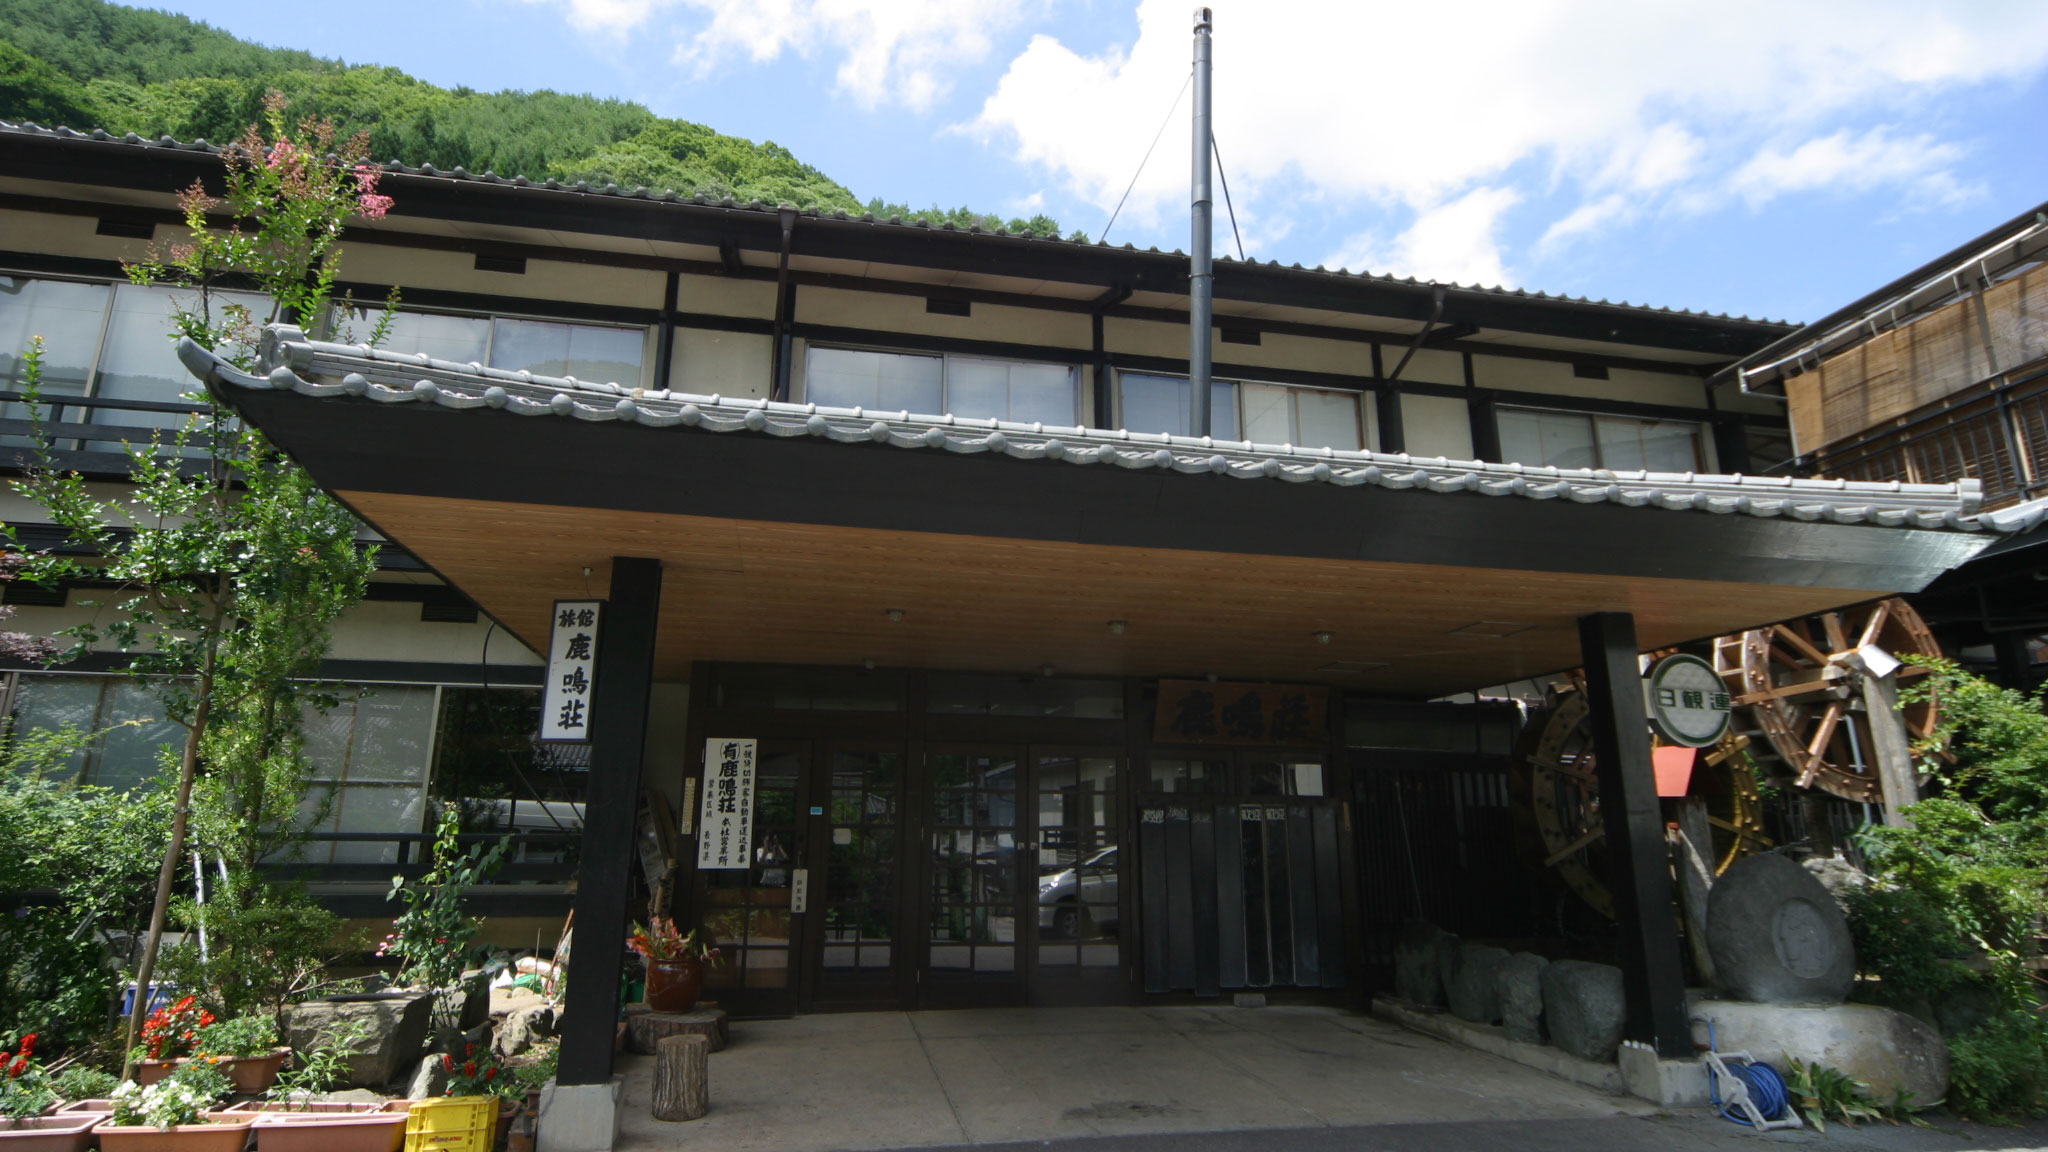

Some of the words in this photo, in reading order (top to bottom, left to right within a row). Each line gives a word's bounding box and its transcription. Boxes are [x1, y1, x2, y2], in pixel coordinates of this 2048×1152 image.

[558, 608, 595, 628] 旅館
[557, 632, 592, 730] 鹿鳴荘
[1657, 687, 1731, 711] 日観連
